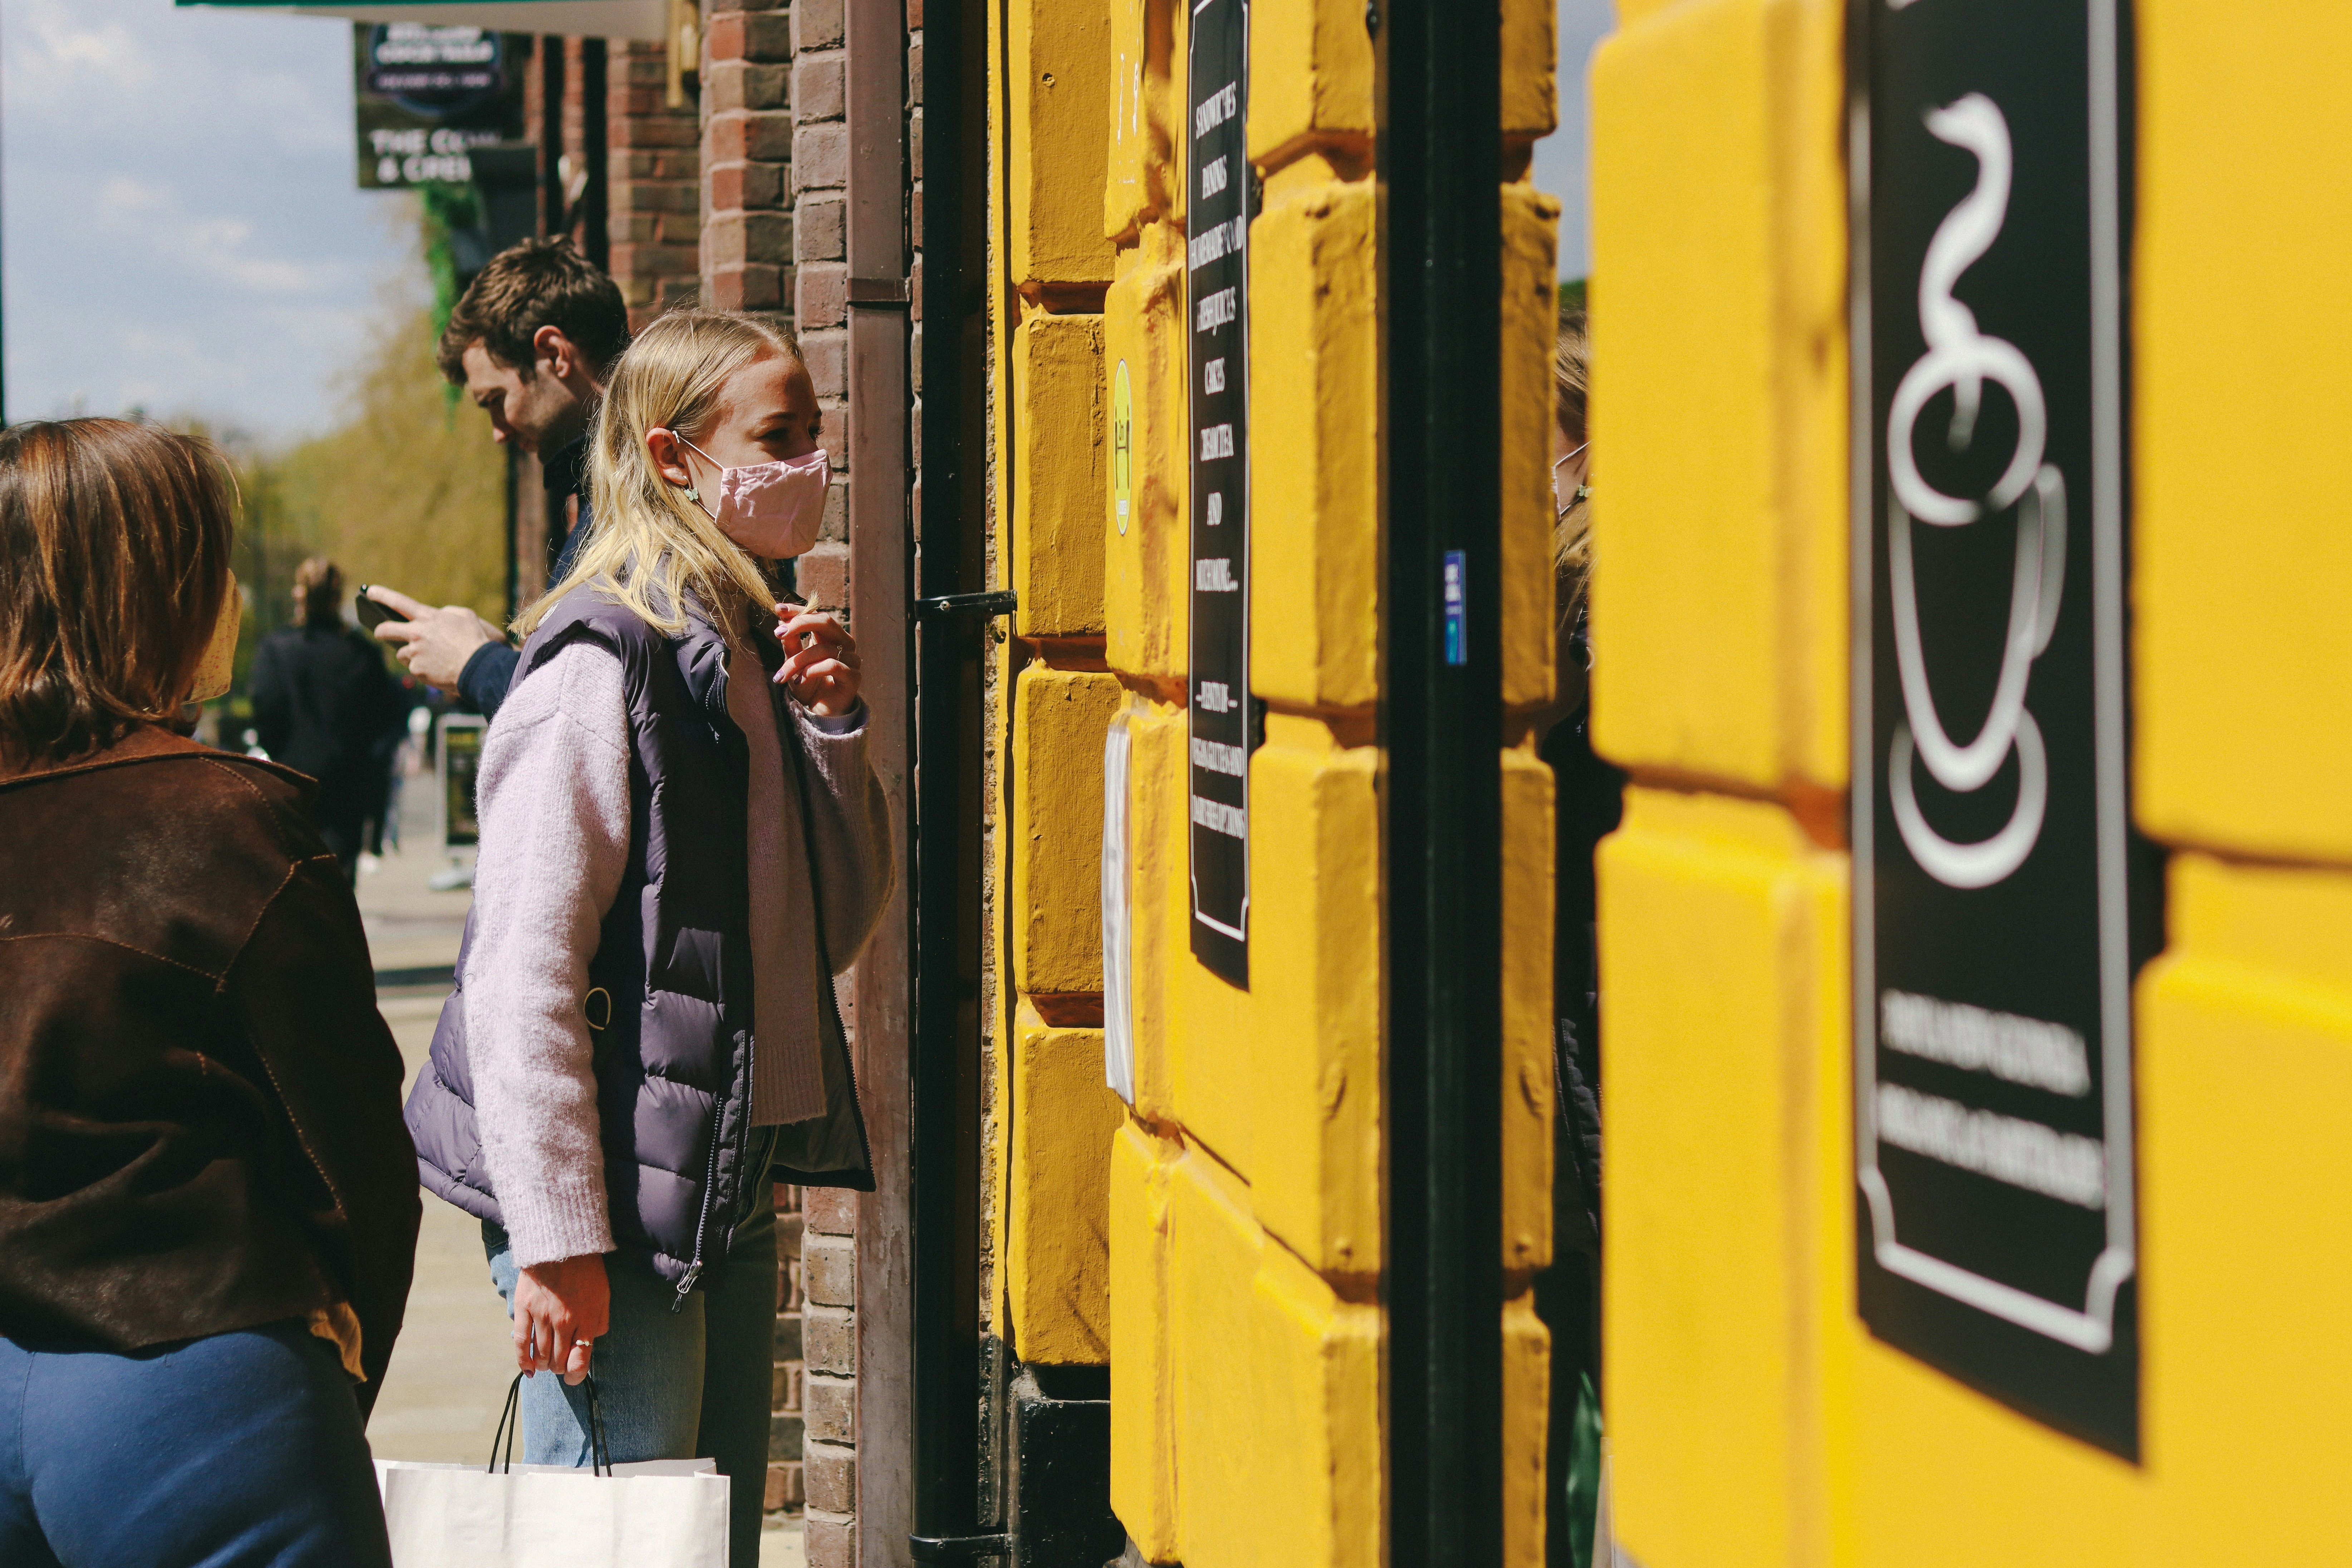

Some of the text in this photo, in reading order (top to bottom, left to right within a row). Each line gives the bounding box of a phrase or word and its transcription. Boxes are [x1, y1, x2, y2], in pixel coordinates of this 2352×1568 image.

[1196, 80, 1236, 140] SANDWICHES
[1202, 154, 1227, 200] PANINIS
[1205, 357, 1225, 395] CAKES
[1207, 492, 1222, 526] AND
